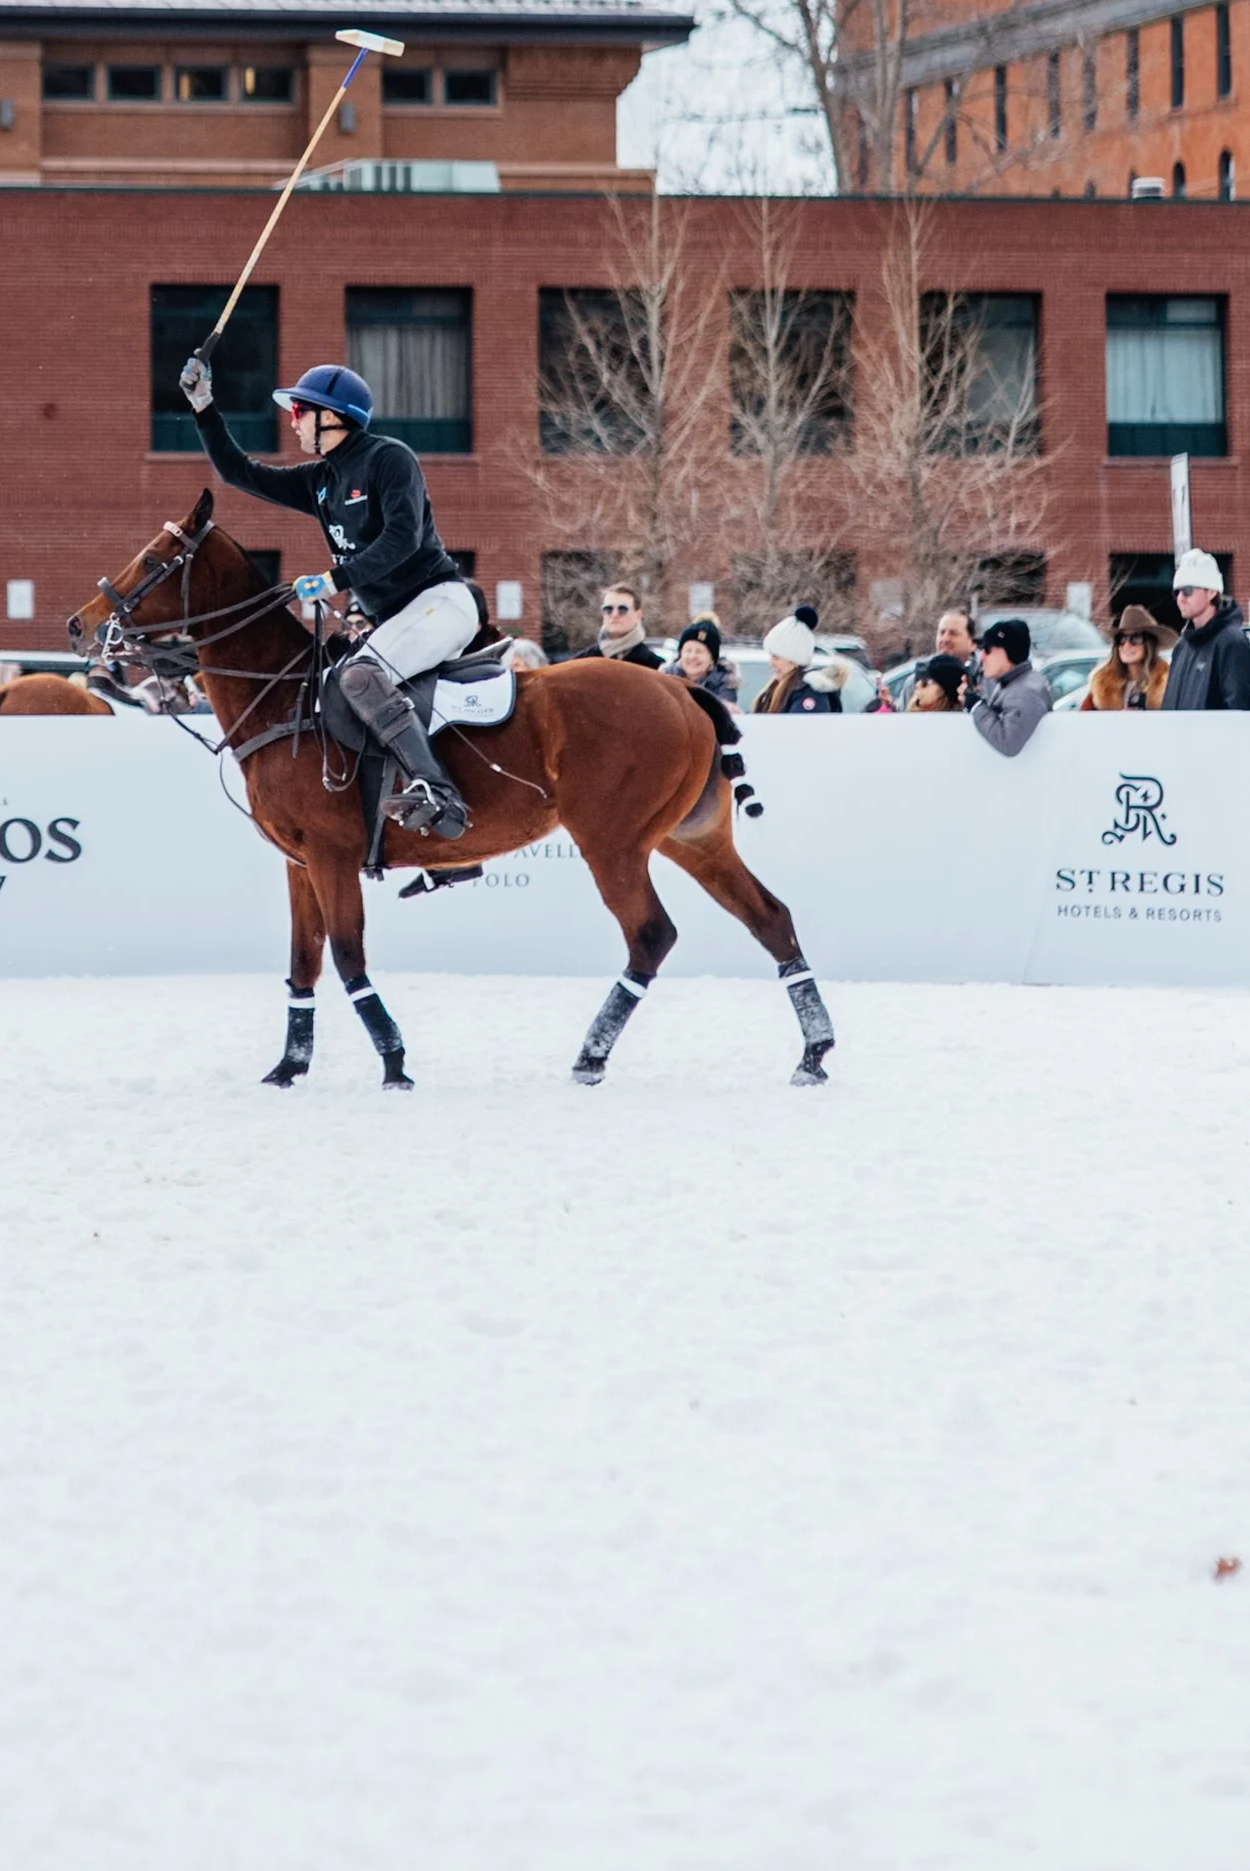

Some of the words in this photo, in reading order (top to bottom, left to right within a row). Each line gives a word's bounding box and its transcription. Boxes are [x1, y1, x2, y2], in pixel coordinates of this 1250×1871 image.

[506, 843, 580, 859] AVELL
[1110, 870, 1224, 897] REGIS
[1057, 903, 1122, 919] HOTELS
[1128, 907, 1139, 920] &
[1146, 907, 1223, 923] RESORTS
